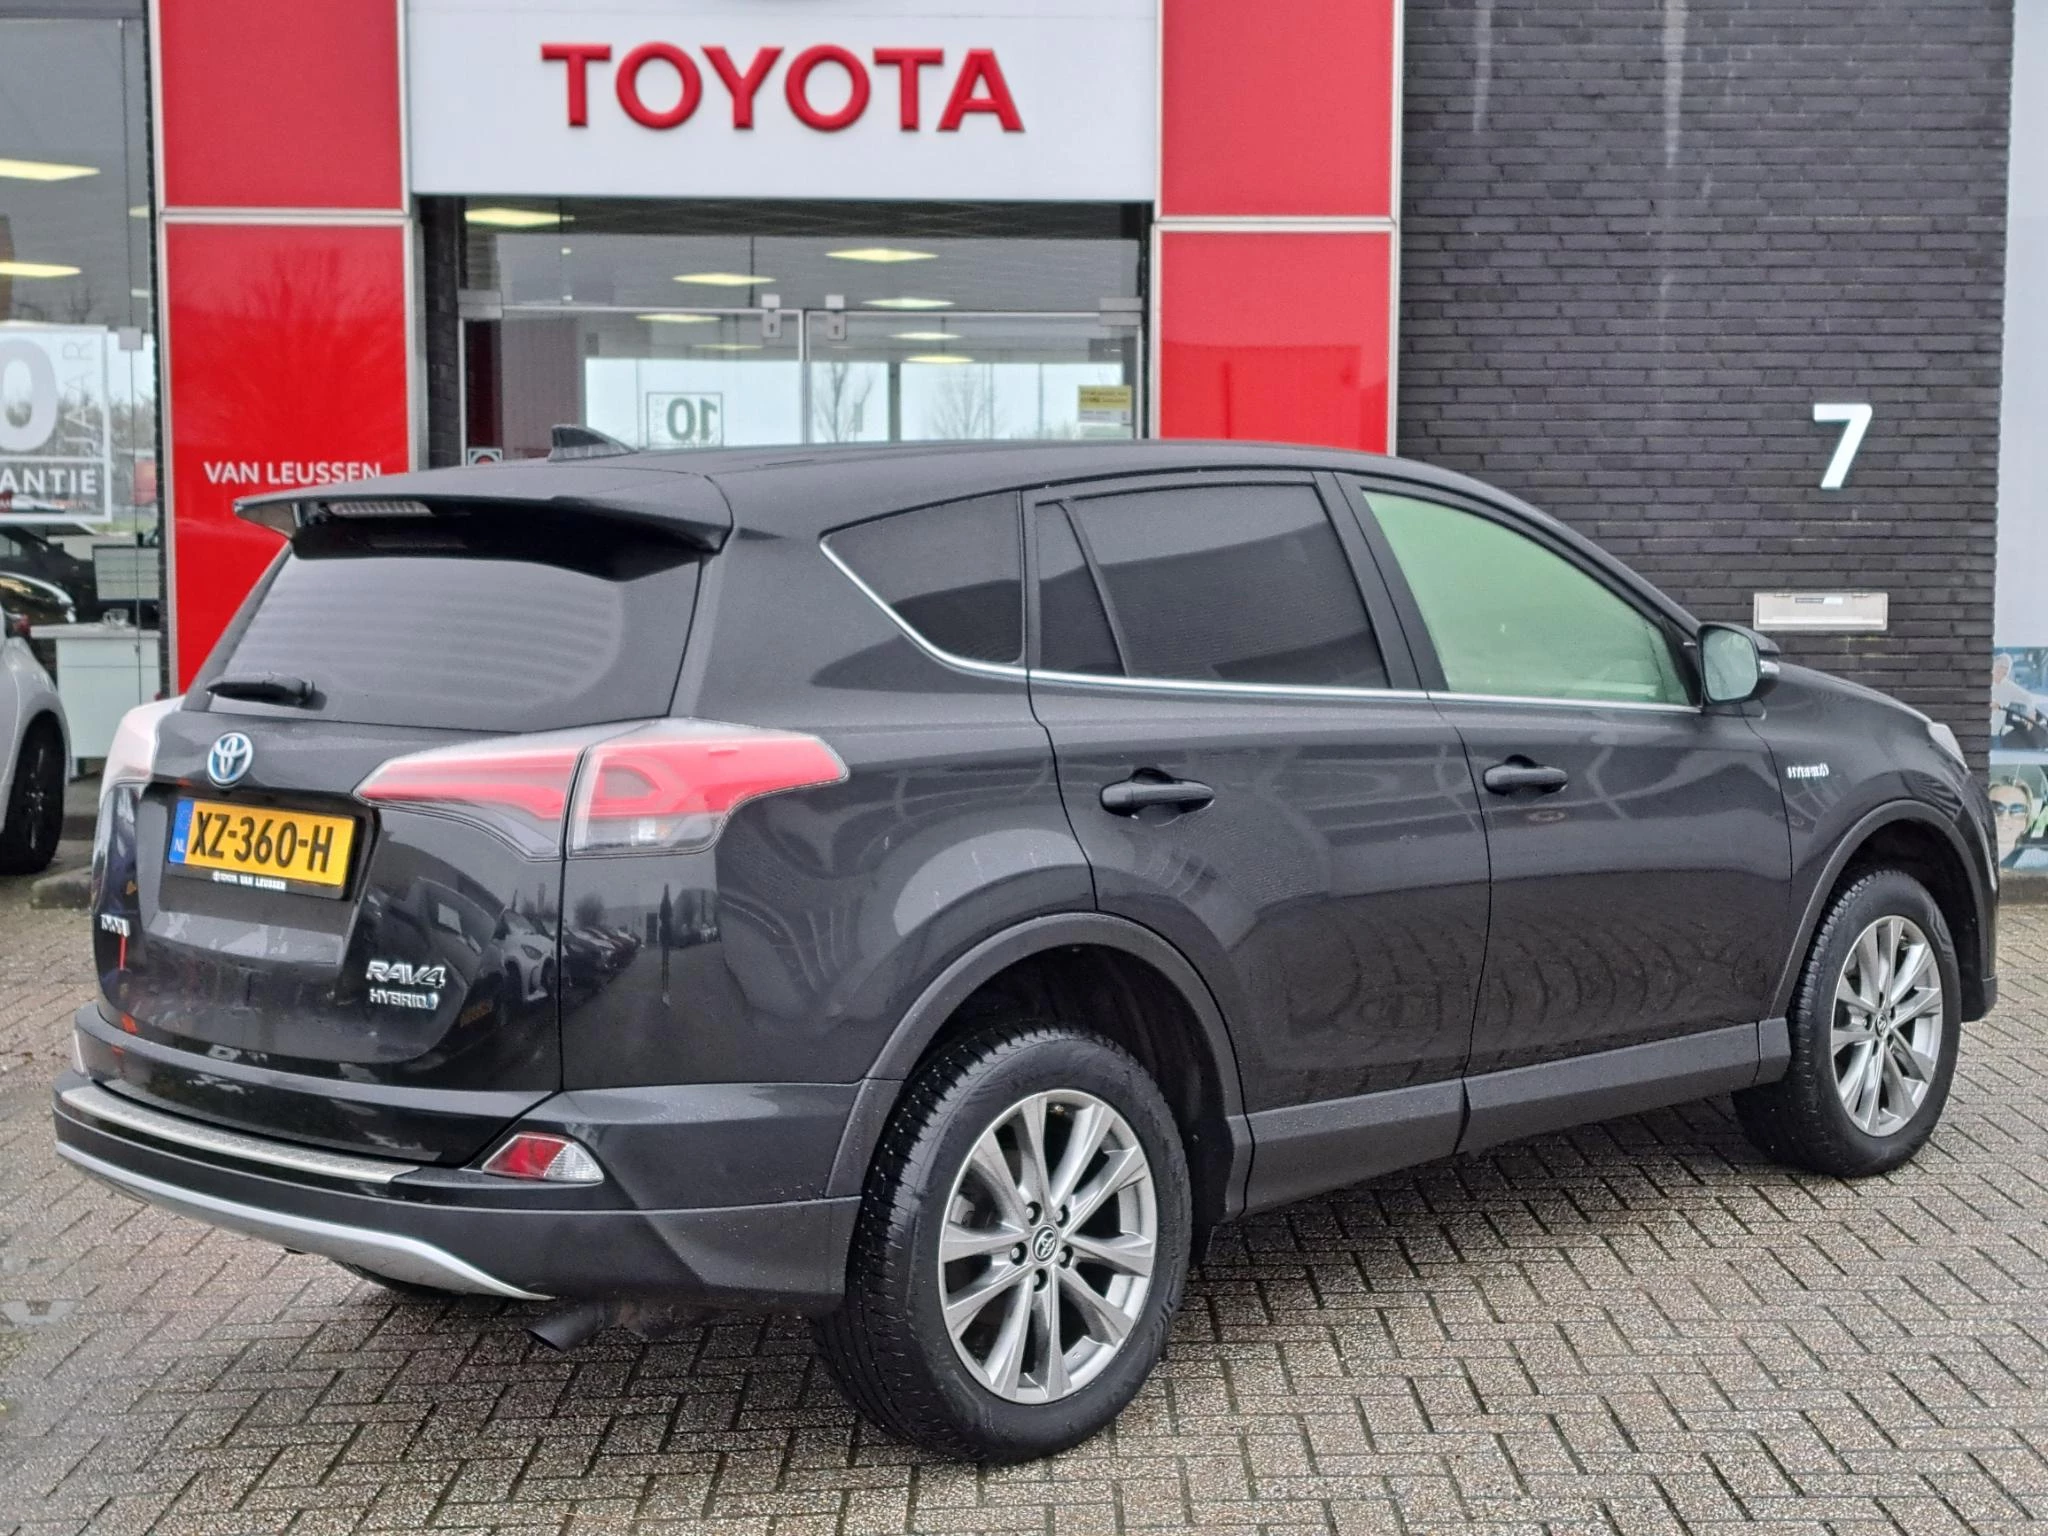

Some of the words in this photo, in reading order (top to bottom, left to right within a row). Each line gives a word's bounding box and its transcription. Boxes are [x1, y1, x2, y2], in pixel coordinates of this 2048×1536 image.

[541, 41, 1025, 133] TOYOTA
[1813, 403, 1873, 489] 7
[203, 461, 260, 485] VAN
[266, 461, 383, 485] LEUSSEN
[190, 810, 335, 873] XZ-360-H
[365, 960, 446, 989] RAV4
[369, 988, 427, 1009] HYBRID
